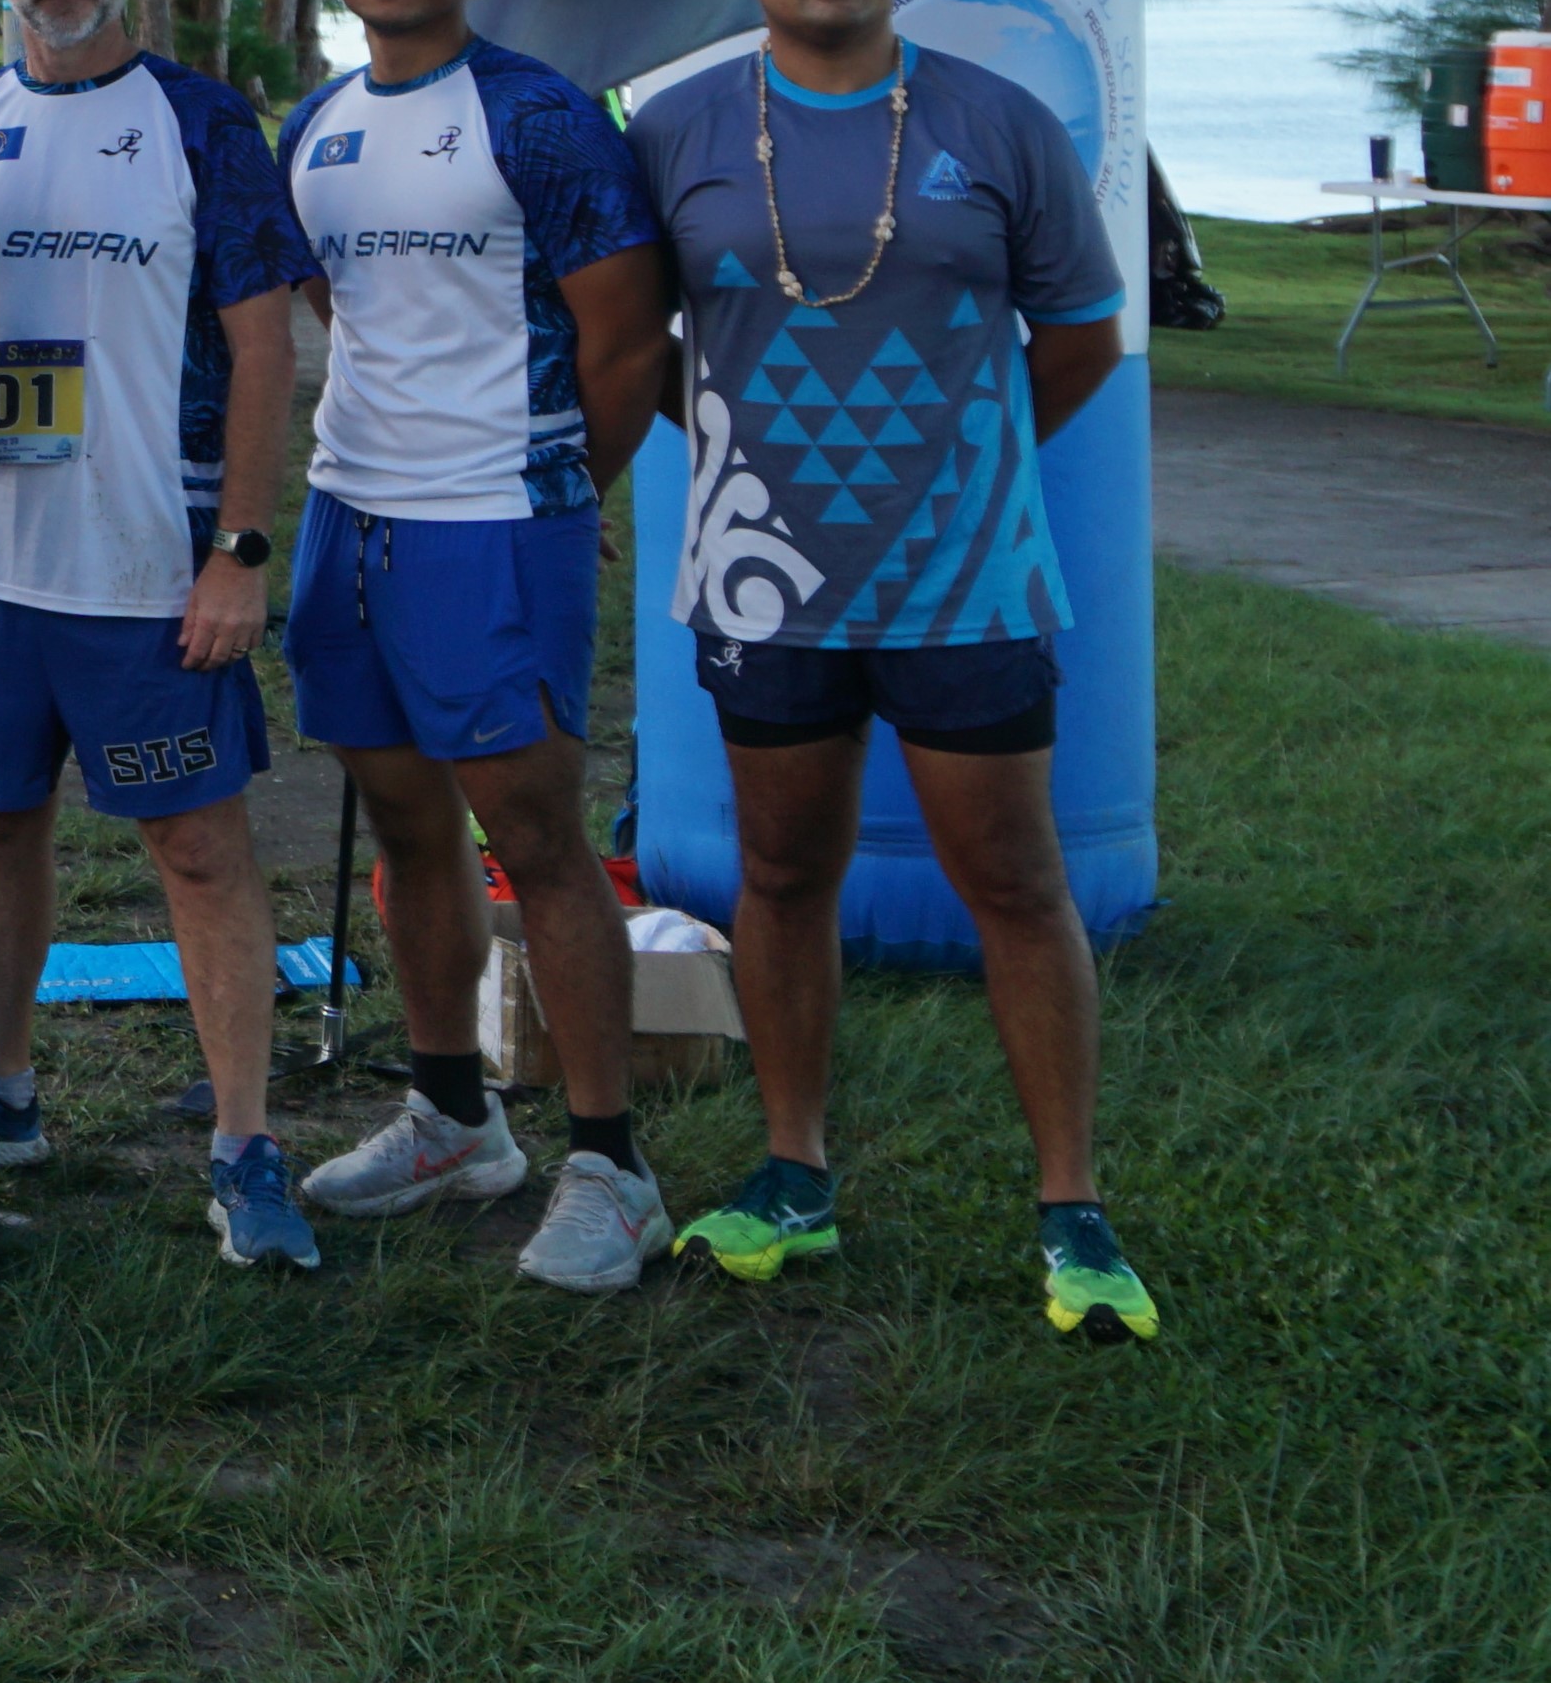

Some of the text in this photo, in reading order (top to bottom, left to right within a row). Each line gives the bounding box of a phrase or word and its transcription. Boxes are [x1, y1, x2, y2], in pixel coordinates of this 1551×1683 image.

[1084, 7, 1118, 142] PERSEVERANCE
[1, 229, 160, 267] SAIPAN
[308, 230, 491, 262] UN SAIPAN
[102, 726, 217, 786] SIS
